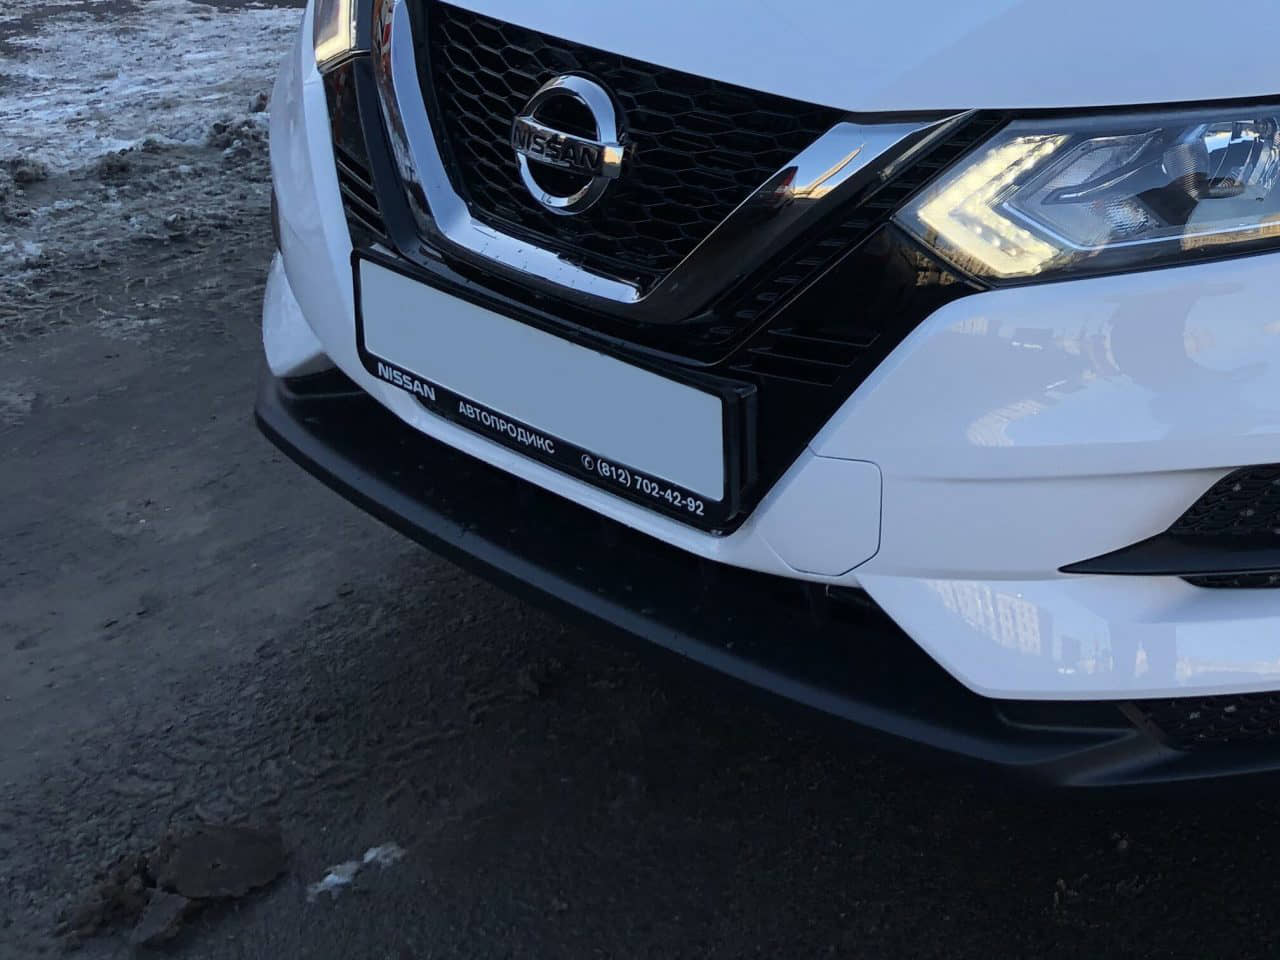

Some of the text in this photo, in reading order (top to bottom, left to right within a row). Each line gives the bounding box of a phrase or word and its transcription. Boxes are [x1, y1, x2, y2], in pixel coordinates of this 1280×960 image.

[514, 126, 602, 170] NISSAN
[378, 361, 436, 401] NISSAN
[459, 401, 555, 454] АВТОПРОДИКС
[597, 459, 704, 516] (812) 702-42-92
